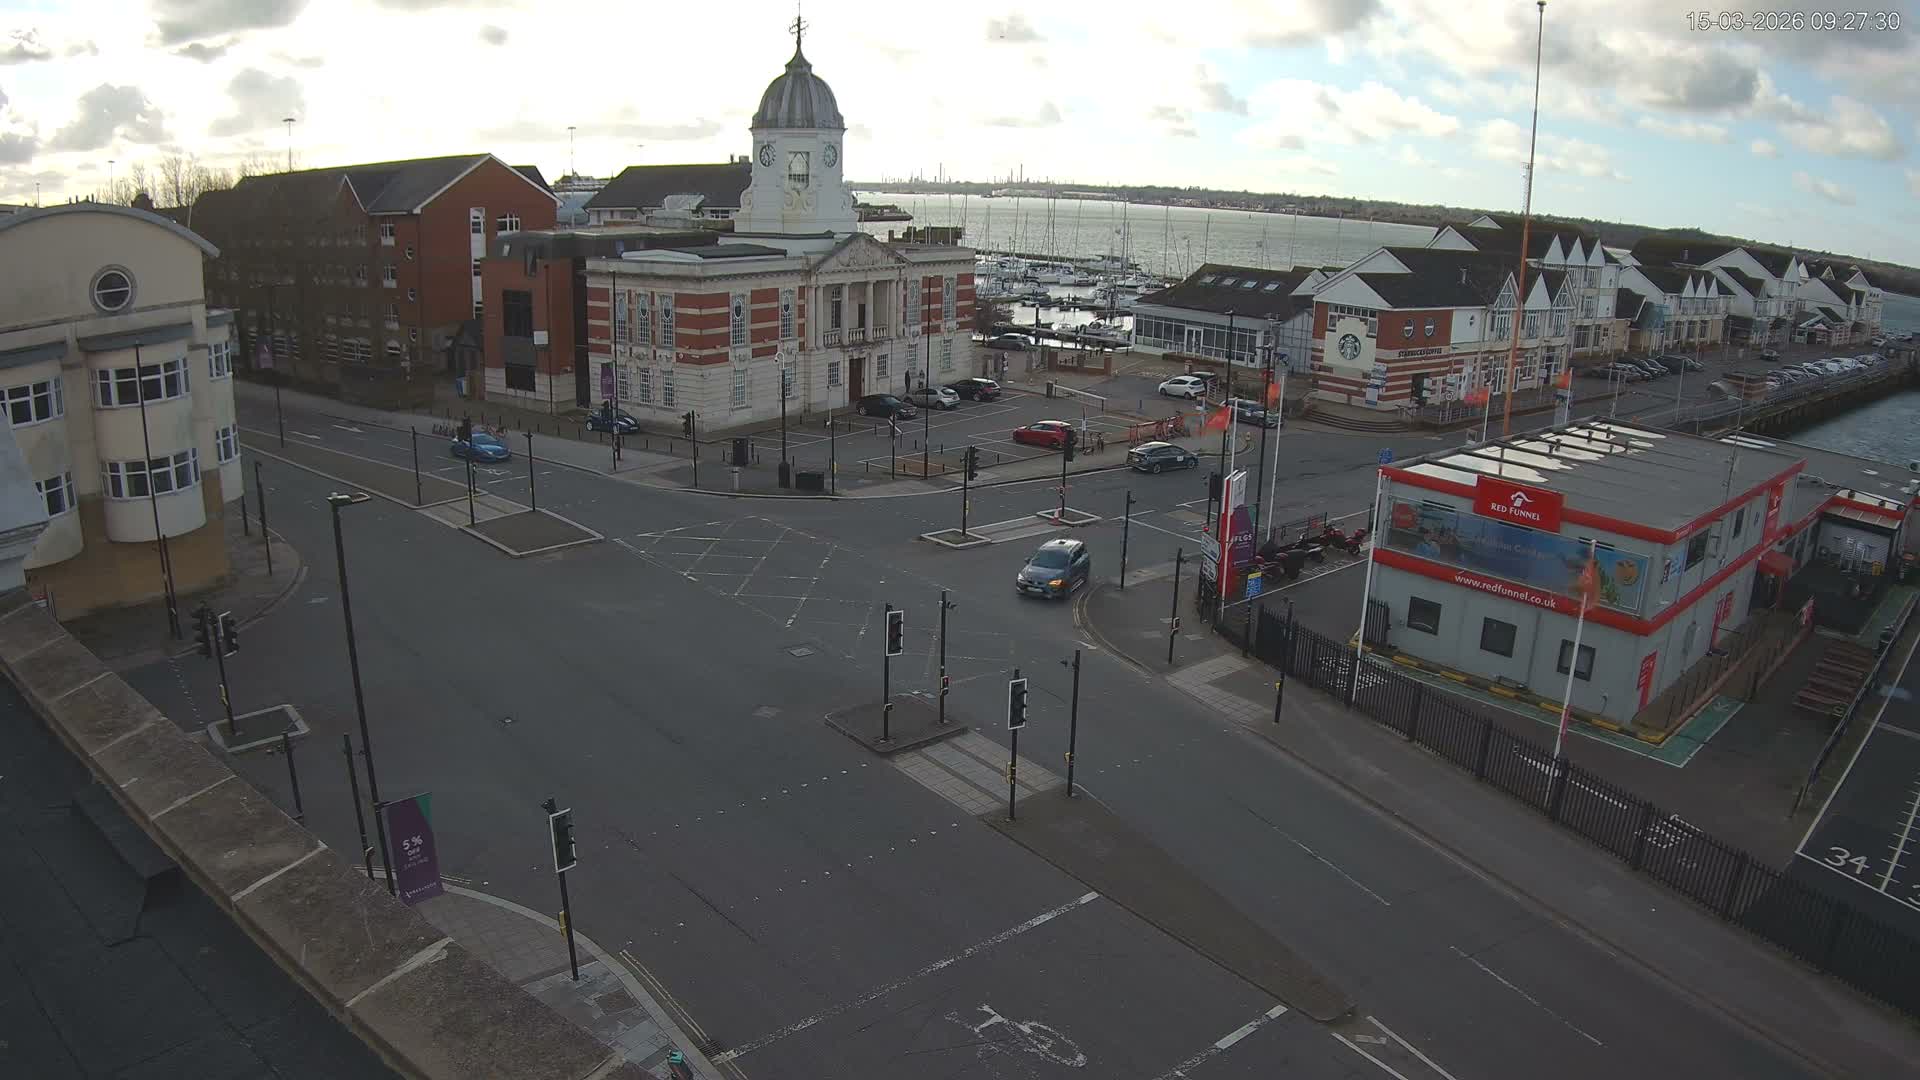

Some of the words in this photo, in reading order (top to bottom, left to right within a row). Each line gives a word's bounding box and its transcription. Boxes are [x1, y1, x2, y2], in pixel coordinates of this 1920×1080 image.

[1398, 349, 1426, 357] STARBUCKS
[1490, 502, 1507, 513] RED
[1509, 507, 1541, 521] FUNNEL
[1454, 574, 1556, 609] www.redfunnel.co.uk
[1824, 846, 1871, 875] 34
